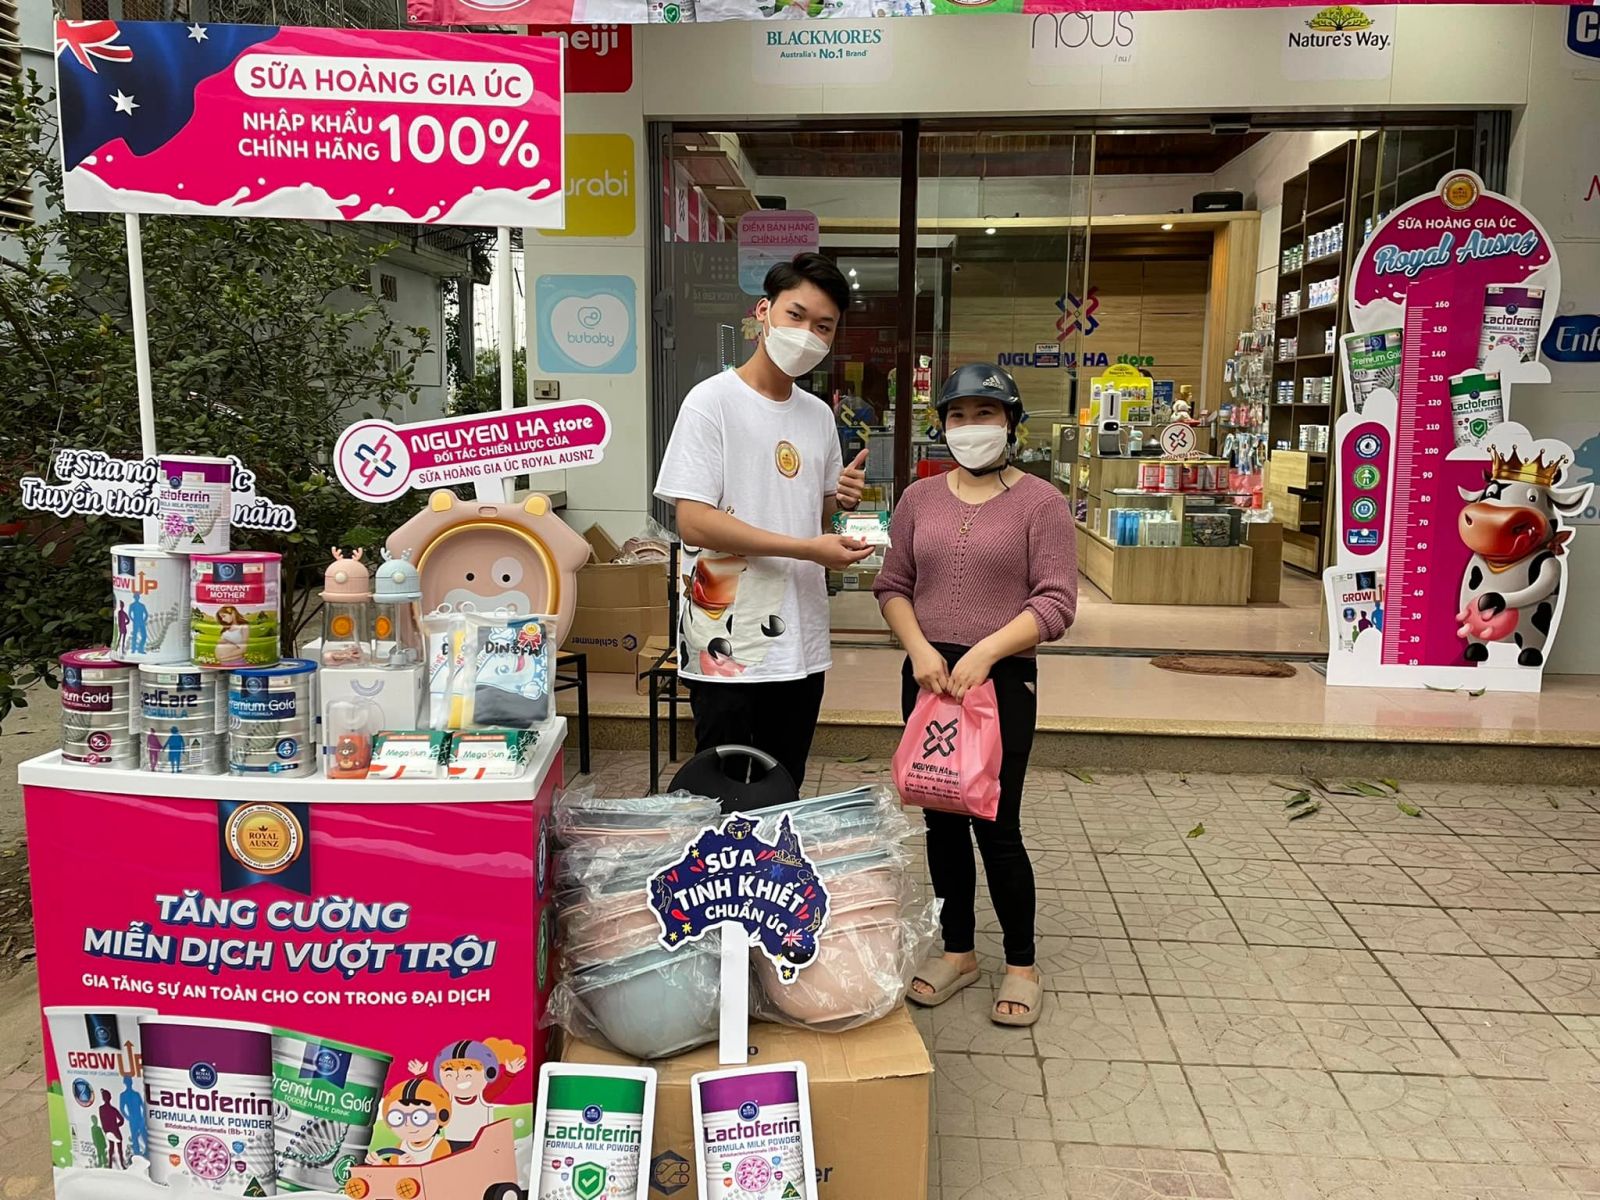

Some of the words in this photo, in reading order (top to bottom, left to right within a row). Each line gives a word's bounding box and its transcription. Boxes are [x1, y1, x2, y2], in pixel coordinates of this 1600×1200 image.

[767, 29, 882, 46] BLACKMORES
[1289, 33, 1352, 47] Nature's
[780, 50, 817, 58] Australia's
[819, 48, 843, 59] No.1
[250, 62, 307, 90] SỮA
[316, 64, 418, 94] HOÀNG
[428, 73, 476, 97] GIA
[485, 69, 522, 98] ÚC
[238, 135, 308, 158] CHÍNH
[316, 138, 380, 161] HÃNG
[242, 109, 305, 135] NHẬP
[311, 108, 373, 134] KHẨU
[379, 113, 540, 168] 100%
[1398, 217, 1423, 229] SỮA
[1426, 216, 1471, 229] HOÀNG
[1475, 218, 1496, 229] GIA
[1500, 215, 1517, 228] ÚC
[1374, 232, 1455, 276] Royal
[1483, 314, 1540, 326] Lactoferrin
[567, 332, 614, 347] bubaby
[1556, 326, 1600, 352] Enf
[998, 353, 1075, 367] NGUN
[1083, 353, 1109, 367] HA
[1117, 353, 1154, 367] store
[1451, 396, 1502, 411] Lactoferrin
[411, 423, 508, 453] NGUYEN
[516, 417, 549, 438] HA
[553, 417, 593, 433] store
[434, 450, 453, 463] ĐỐI
[456, 447, 477, 461] TÁC
[479, 442, 512, 458] CHIẾN
[514, 439, 544, 454] LƯỢC
[547, 434, 570, 447] CỦA
[58, 452, 123, 479] #Sữa
[126, 458, 159, 487] nộ
[419, 470, 442, 484] SỮA
[444, 464, 481, 480] HOÀNG
[483, 463, 501, 475] GIA
[504, 459, 519, 472] ÚC
[522, 454, 556, 469] ROYAL
[559, 450, 594, 464] AUSNZ
[22, 480, 102, 515] Truyền
[107, 488, 160, 516] thốn
[234, 499, 292, 527] năm
[131, 571, 158, 595] UP
[1343, 591, 1372, 602] GROW
[1412, 612, 1422, 620] 30
[572, 636, 619, 647] Schlemmer
[1410, 635, 1420, 643] 20
[82, 692, 109, 703] Gold
[268, 699, 296, 711] Gold
[705, 846, 756, 873] SỮA
[738, 875, 804, 913] KHIẾT
[156, 889, 258, 927] TĂNG
[267, 895, 411, 931] CƯỜNG
[705, 900, 765, 923] CHUẨN
[766, 914, 788, 936] ÚC
[83, 921, 173, 963] MIỄN
[180, 937, 274, 973] DỊCH
[284, 938, 395, 977] VƯỢT
[402, 934, 497, 975] TRỘI
[82, 973, 109, 989] GIA
[112, 974, 154, 993] TĂNG
[158, 981, 180, 1000] SỰ
[183, 985, 206, 999] AN
[210, 985, 257, 1002] TOÀN
[262, 989, 299, 1004] CHO
[303, 991, 340, 1005] CON
[345, 991, 408, 1005] TRONG
[412, 991, 443, 1007] ĐẠI
[448, 988, 490, 1006] DỊCH
[68, 1052, 115, 1070] GROW
[145, 1083, 273, 1116] Lactoferrin
[284, 1094, 313, 1108] TODDLER
[314, 1103, 330, 1112] MILK
[340, 1092, 373, 1113] Gold
[149, 1110, 197, 1123] FORMULA
[200, 1115, 225, 1126] MILK
[228, 1118, 272, 1129] POWDER
[704, 1117, 801, 1144] Lactoferrin
[544, 1121, 641, 1144] Lactoferrin
[545, 1140, 583, 1149] FORMULA
[585, 1142, 604, 1151] MILK
[606, 1143, 640, 1152] POWDER
[707, 1142, 745, 1154] FORMULA
[747, 1139, 766, 1149] MILK
[768, 1135, 801, 1146] POWDER
